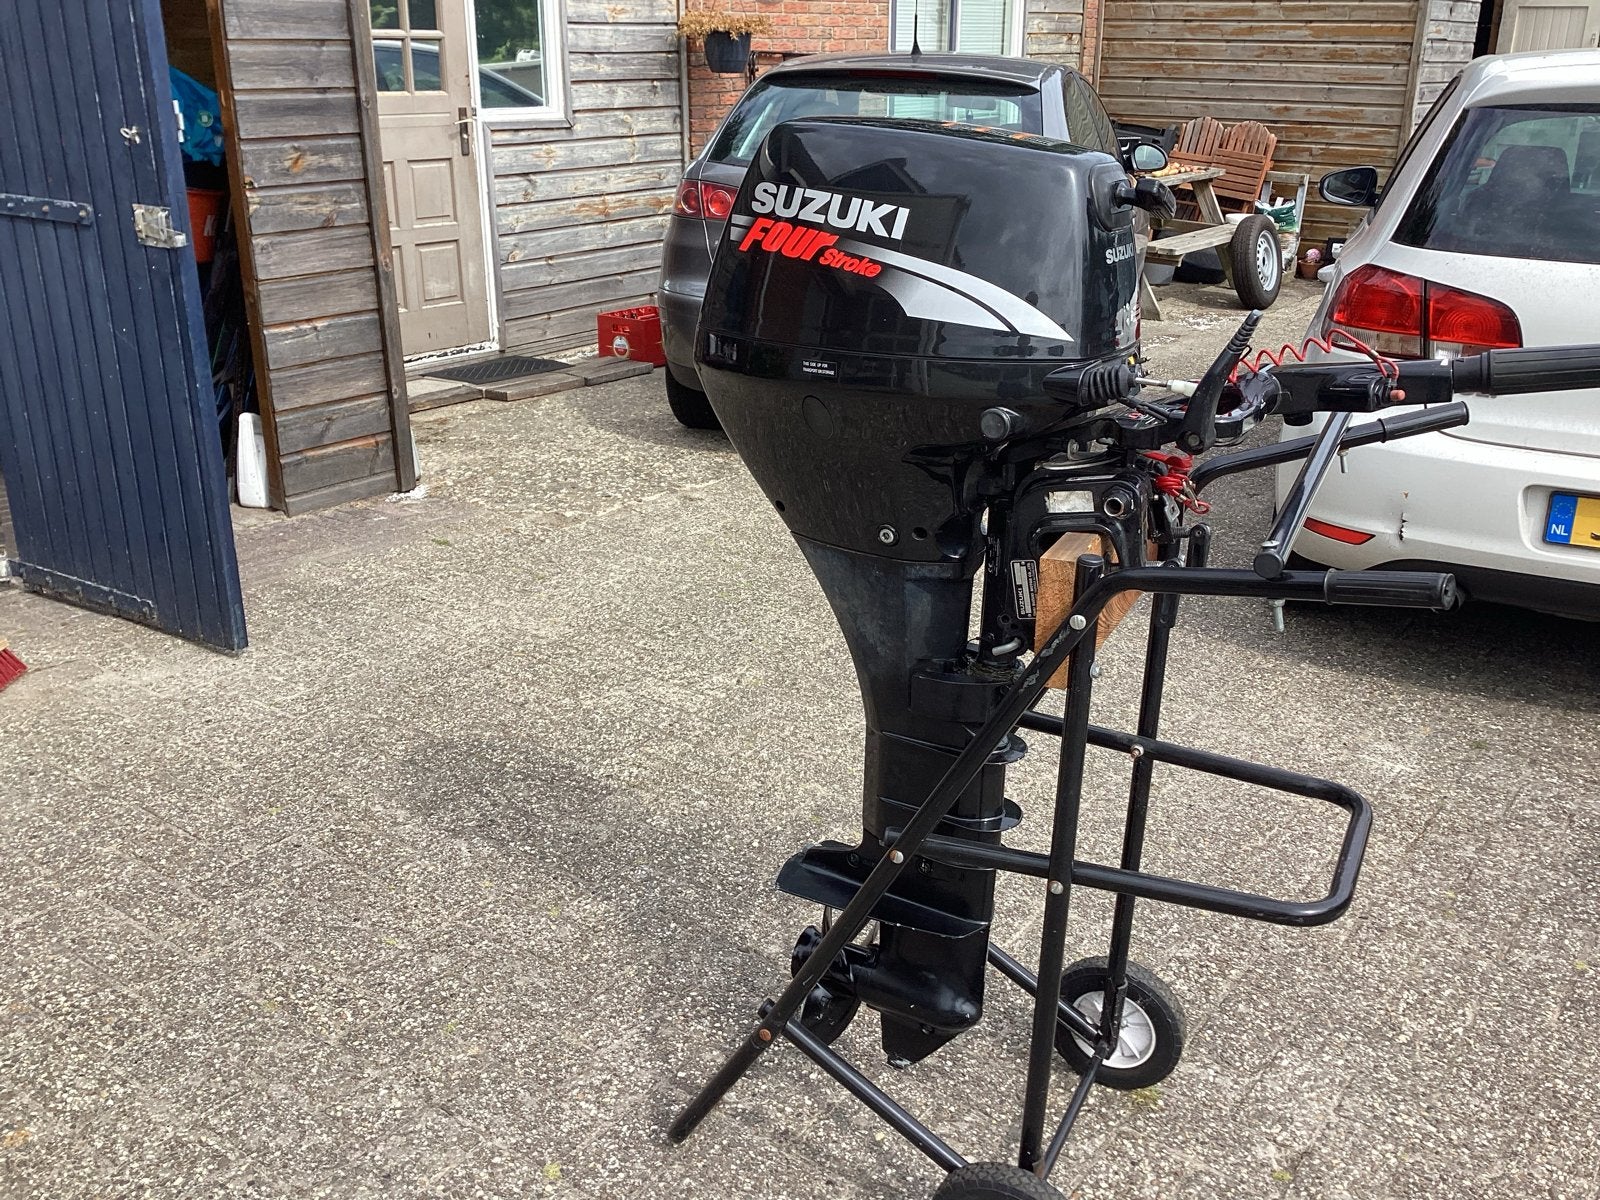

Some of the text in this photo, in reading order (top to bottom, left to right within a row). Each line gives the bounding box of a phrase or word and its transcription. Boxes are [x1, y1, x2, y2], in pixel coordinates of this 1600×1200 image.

[751, 181, 910, 240] SUZUKI
[819, 248, 882, 278] Stroke
[1105, 242, 1134, 265] SUZUKI
[1550, 523, 1569, 536] NL
[1017, 587, 1026, 615] SUZUKI
